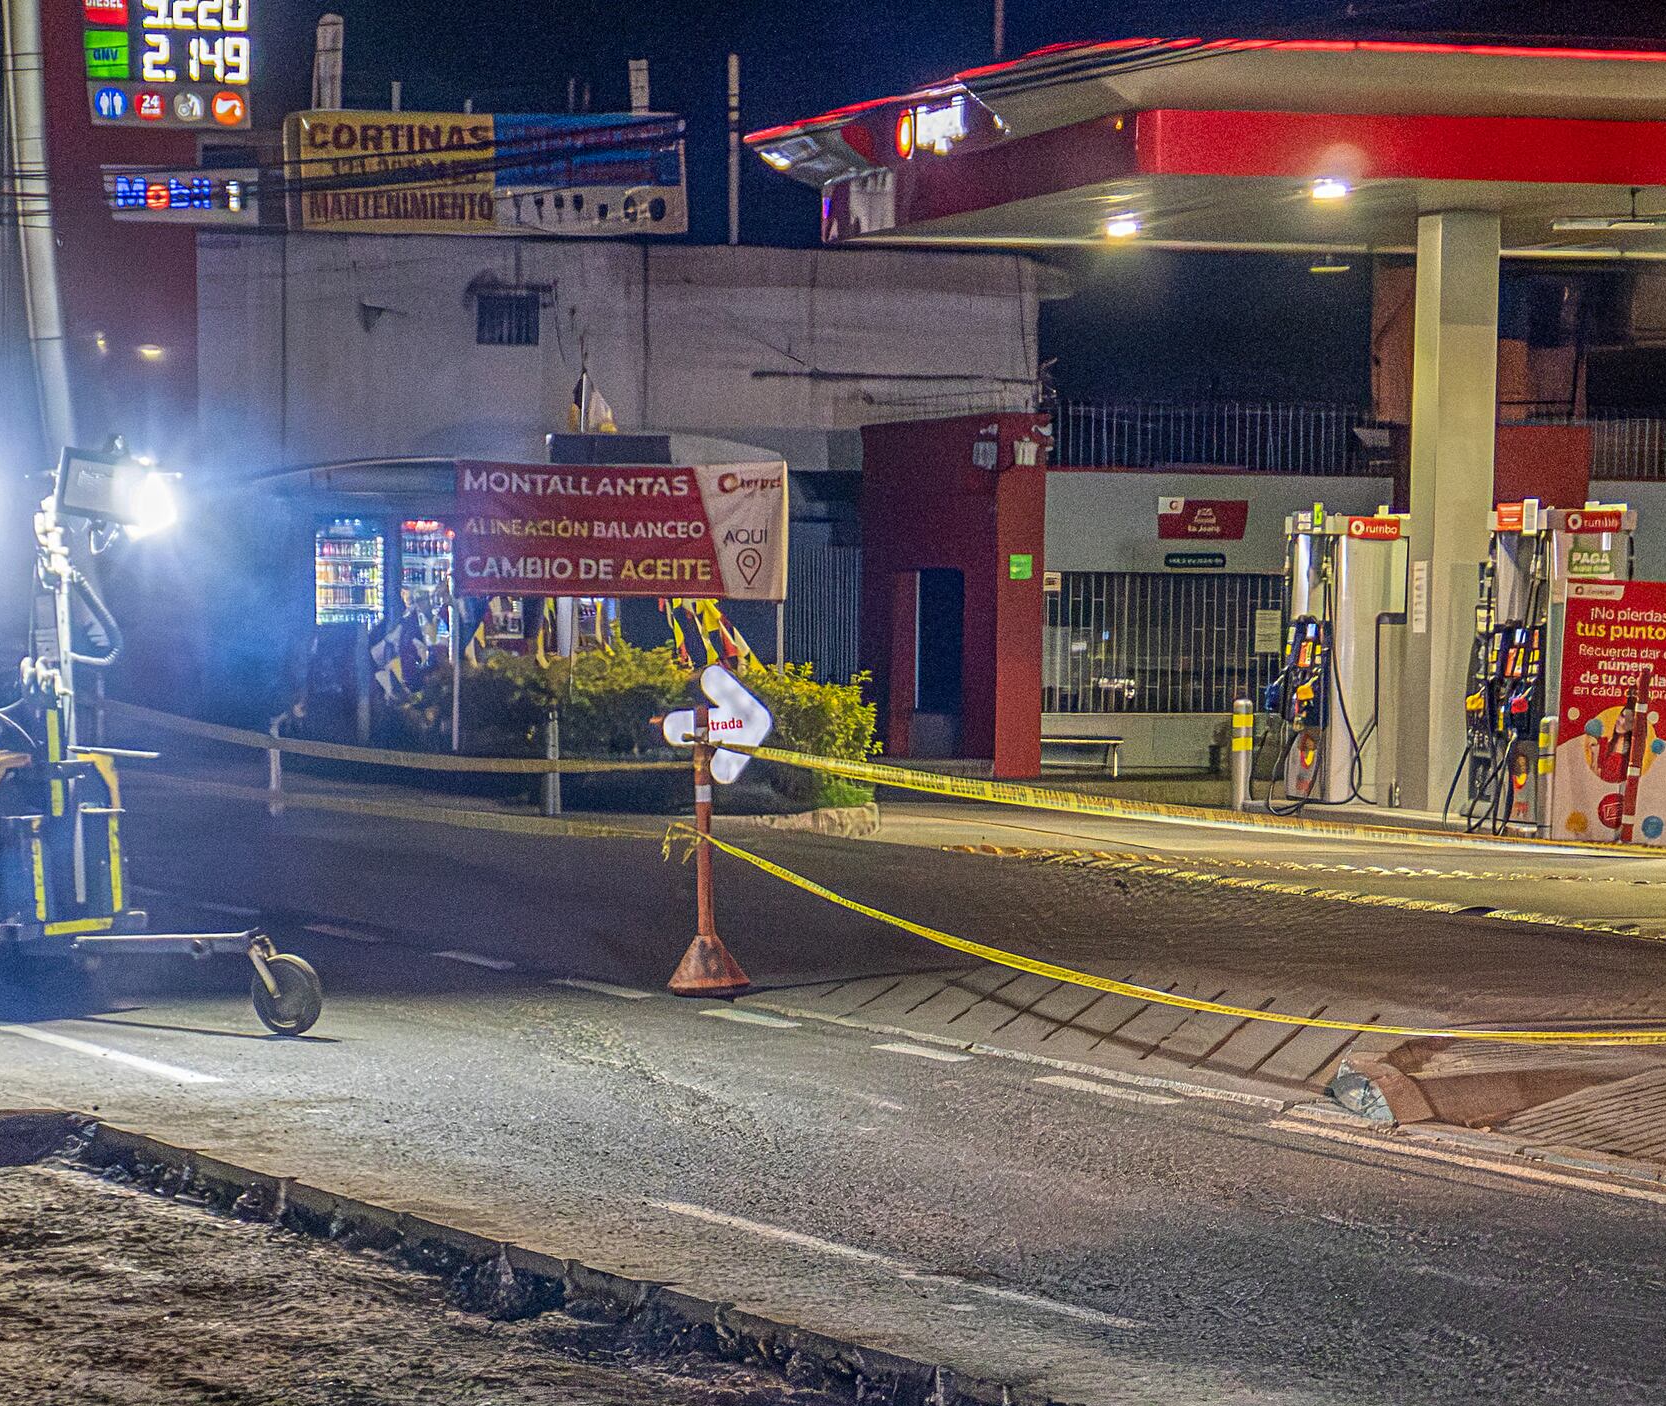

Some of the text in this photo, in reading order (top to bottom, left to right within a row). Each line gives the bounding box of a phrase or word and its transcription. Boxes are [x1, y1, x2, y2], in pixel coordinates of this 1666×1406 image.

[93, 34, 250, 85] GNV 2.149
[141, 95, 161, 108] 24
[308, 123, 491, 151] CORTINAS
[116, 176, 212, 211] Mobil
[463, 468, 689, 497] MONTALLANTAS
[465, 515, 705, 539] ALINEACIÓN BALANCEO
[723, 519, 768, 546] AQUÍ
[463, 555, 712, 581] CAMBIO DE ACEITE
[1576, 621, 1606, 637] tus
[1579, 643, 1637, 658] Recuerda
[1640, 648, 1661, 659] dar
[1580, 671, 1599, 684] de
[1602, 674, 1616, 686] tu
[1573, 687, 1589, 696] en
[1591, 686, 1622, 697] cada
